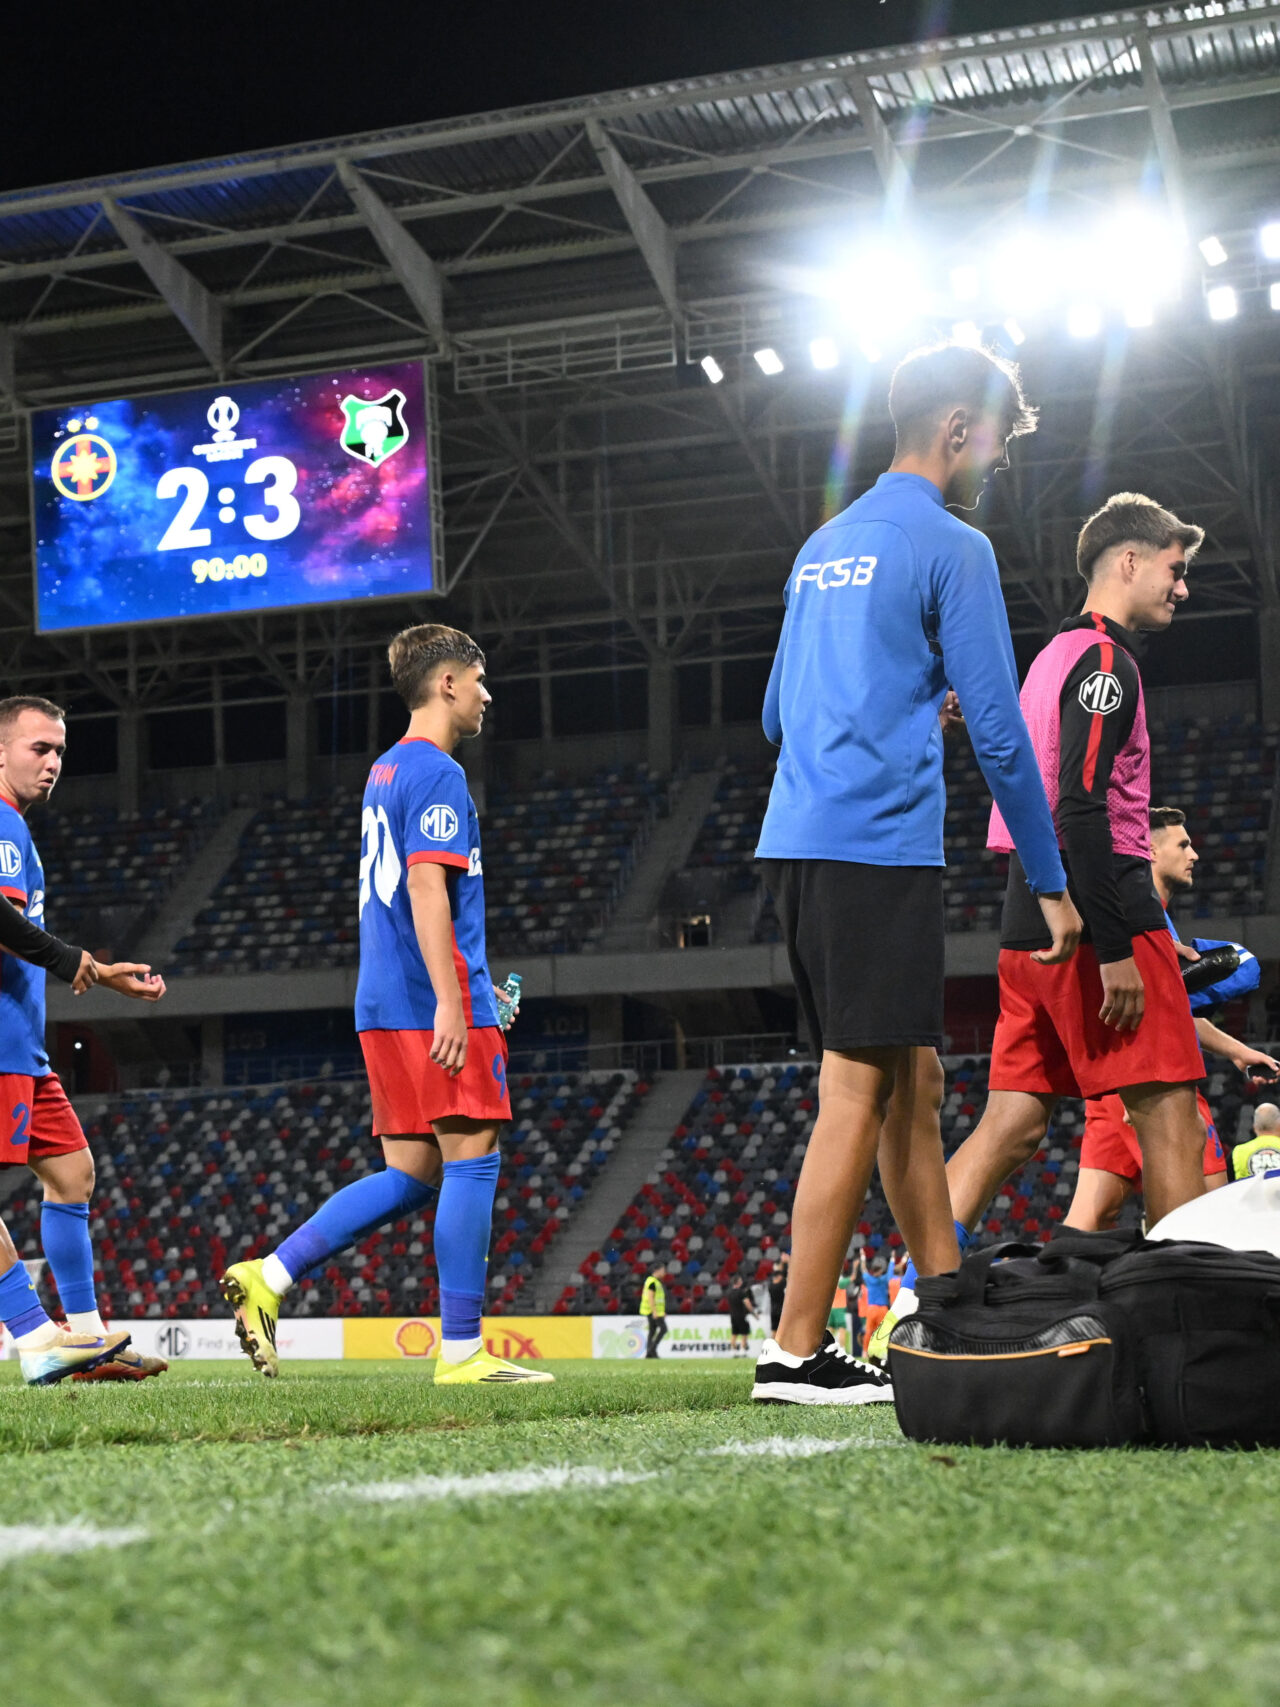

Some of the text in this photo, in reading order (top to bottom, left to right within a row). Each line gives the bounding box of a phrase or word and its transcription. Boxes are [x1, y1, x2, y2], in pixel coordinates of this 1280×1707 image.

[192, 553, 267, 583] 90:00
[795, 556, 877, 593] FCSB
[1081, 674, 1120, 712] MG
[422, 806, 457, 839] MG
[492, 1053, 507, 1100] 9
[159, 1327, 188, 1356] MG
[486, 1330, 543, 1358] LIX
[663, 1328, 702, 1340] DEAL
[671, 1342, 750, 1352] ADVERTISI
